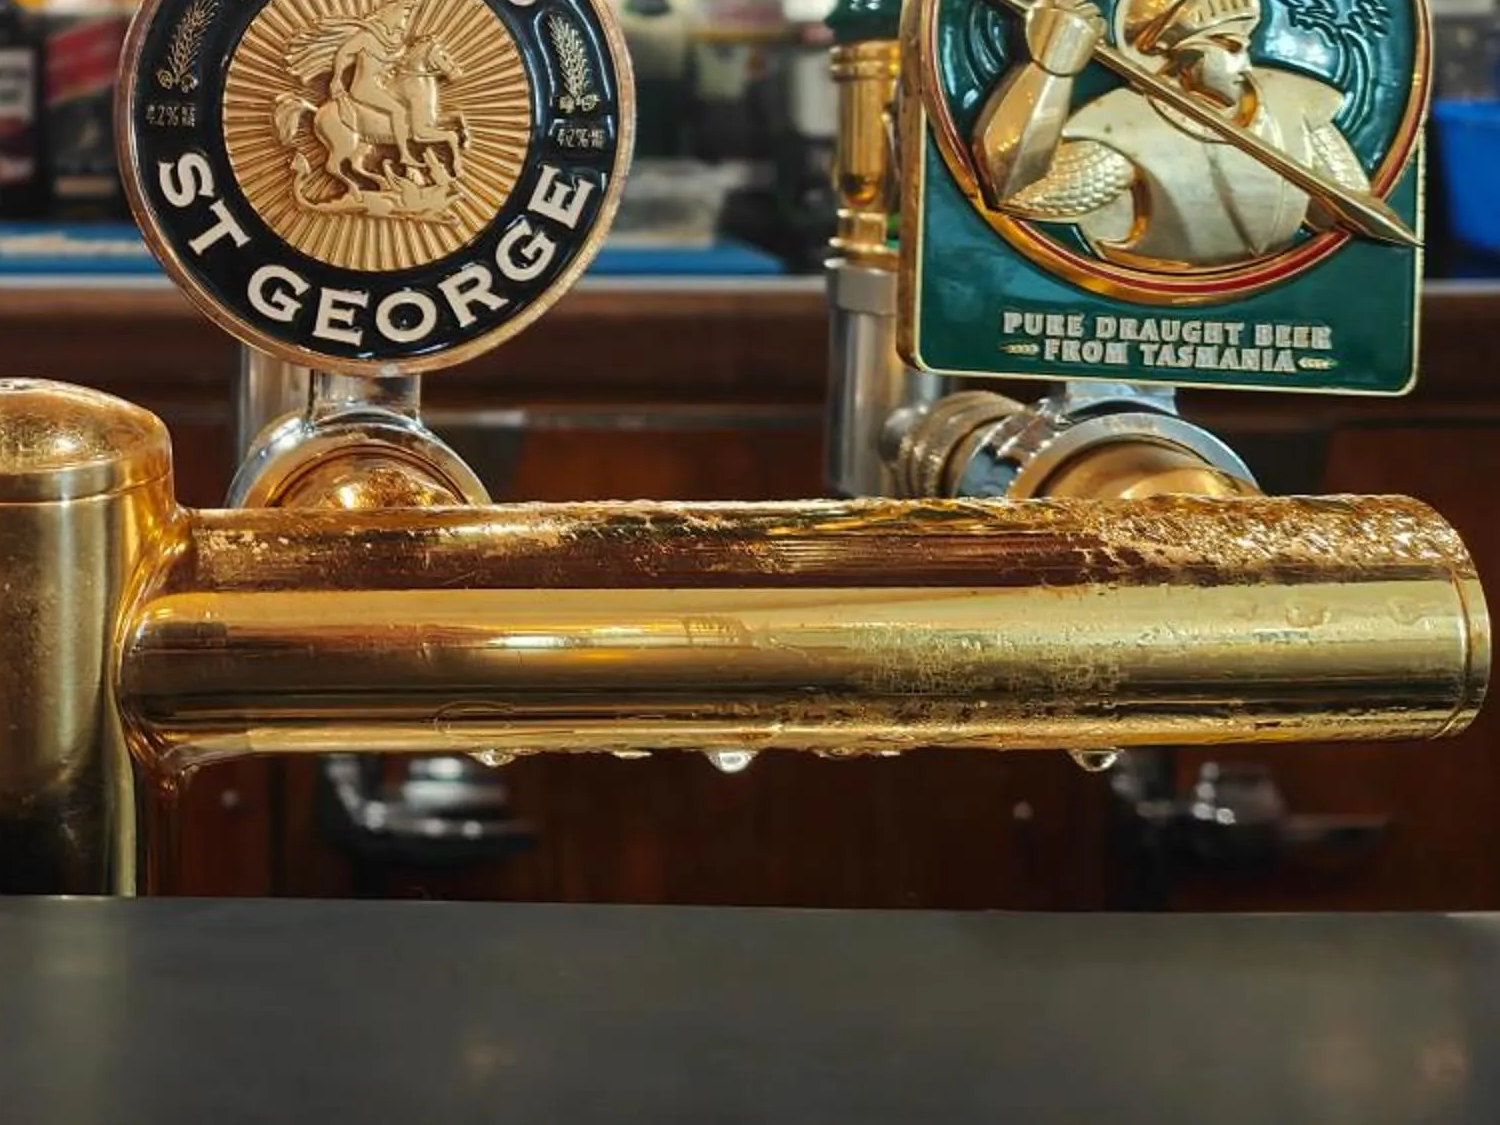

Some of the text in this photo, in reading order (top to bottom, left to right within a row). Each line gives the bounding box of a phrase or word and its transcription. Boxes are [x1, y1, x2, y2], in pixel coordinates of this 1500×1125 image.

[159, 151, 597, 346] ST GEORGE
[1003, 312, 1332, 350] PURE DRAUGHT BEER
[1044, 339, 1296, 373] FROM TASMANIA
